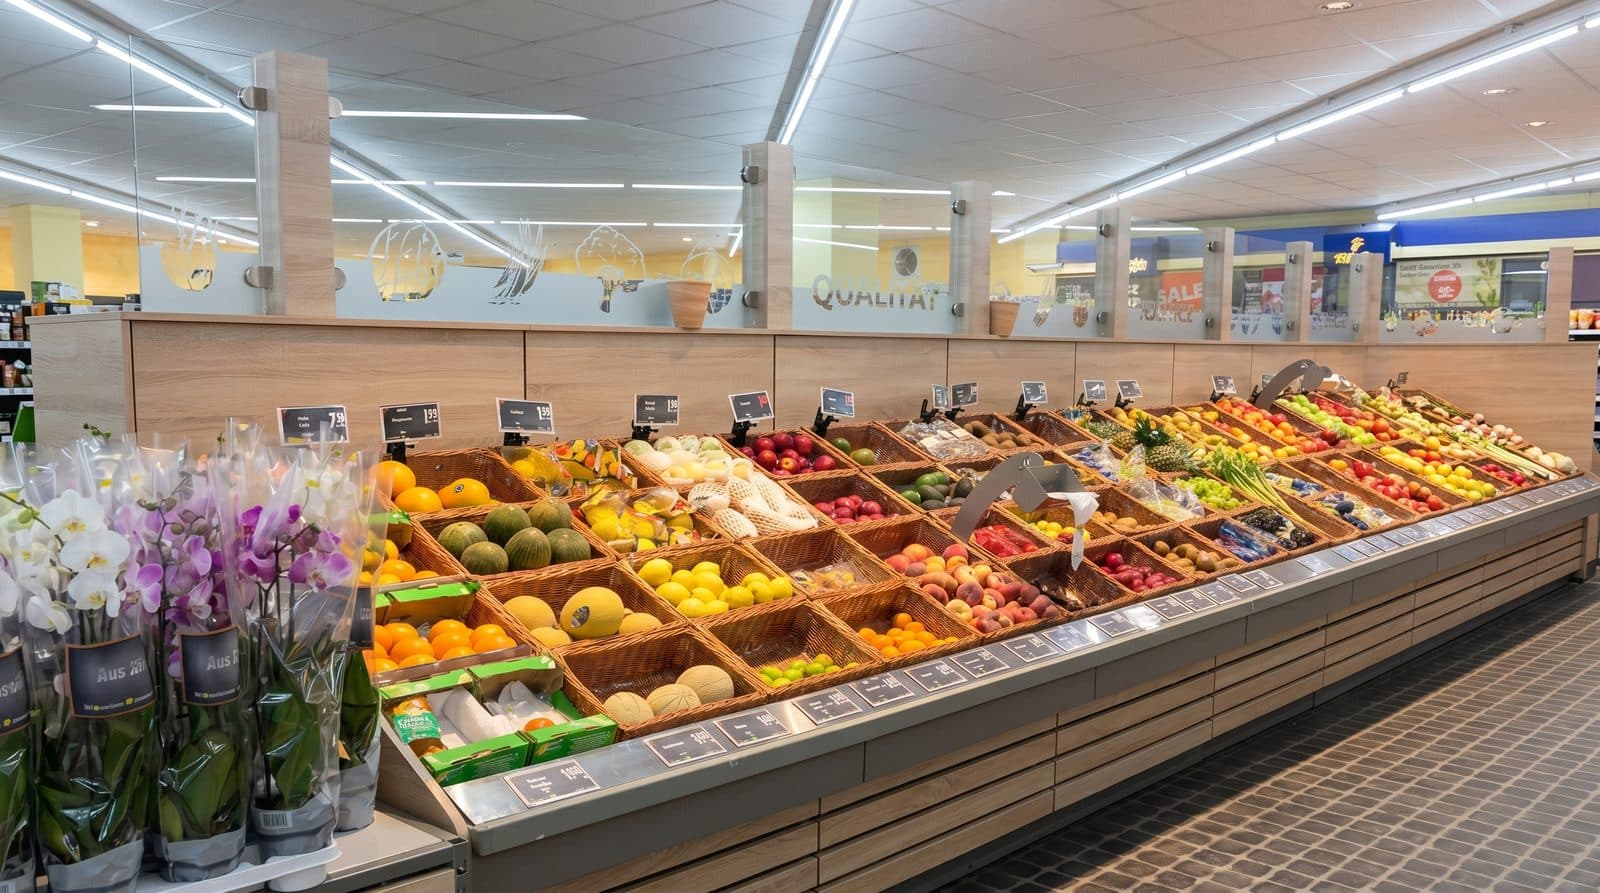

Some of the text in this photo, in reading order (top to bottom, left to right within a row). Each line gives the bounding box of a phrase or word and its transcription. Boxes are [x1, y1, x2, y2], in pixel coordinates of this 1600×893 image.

[1157, 281, 1203, 305] SALE
[206, 654, 231, 672] Aus
[96, 666, 126, 683] Aus
